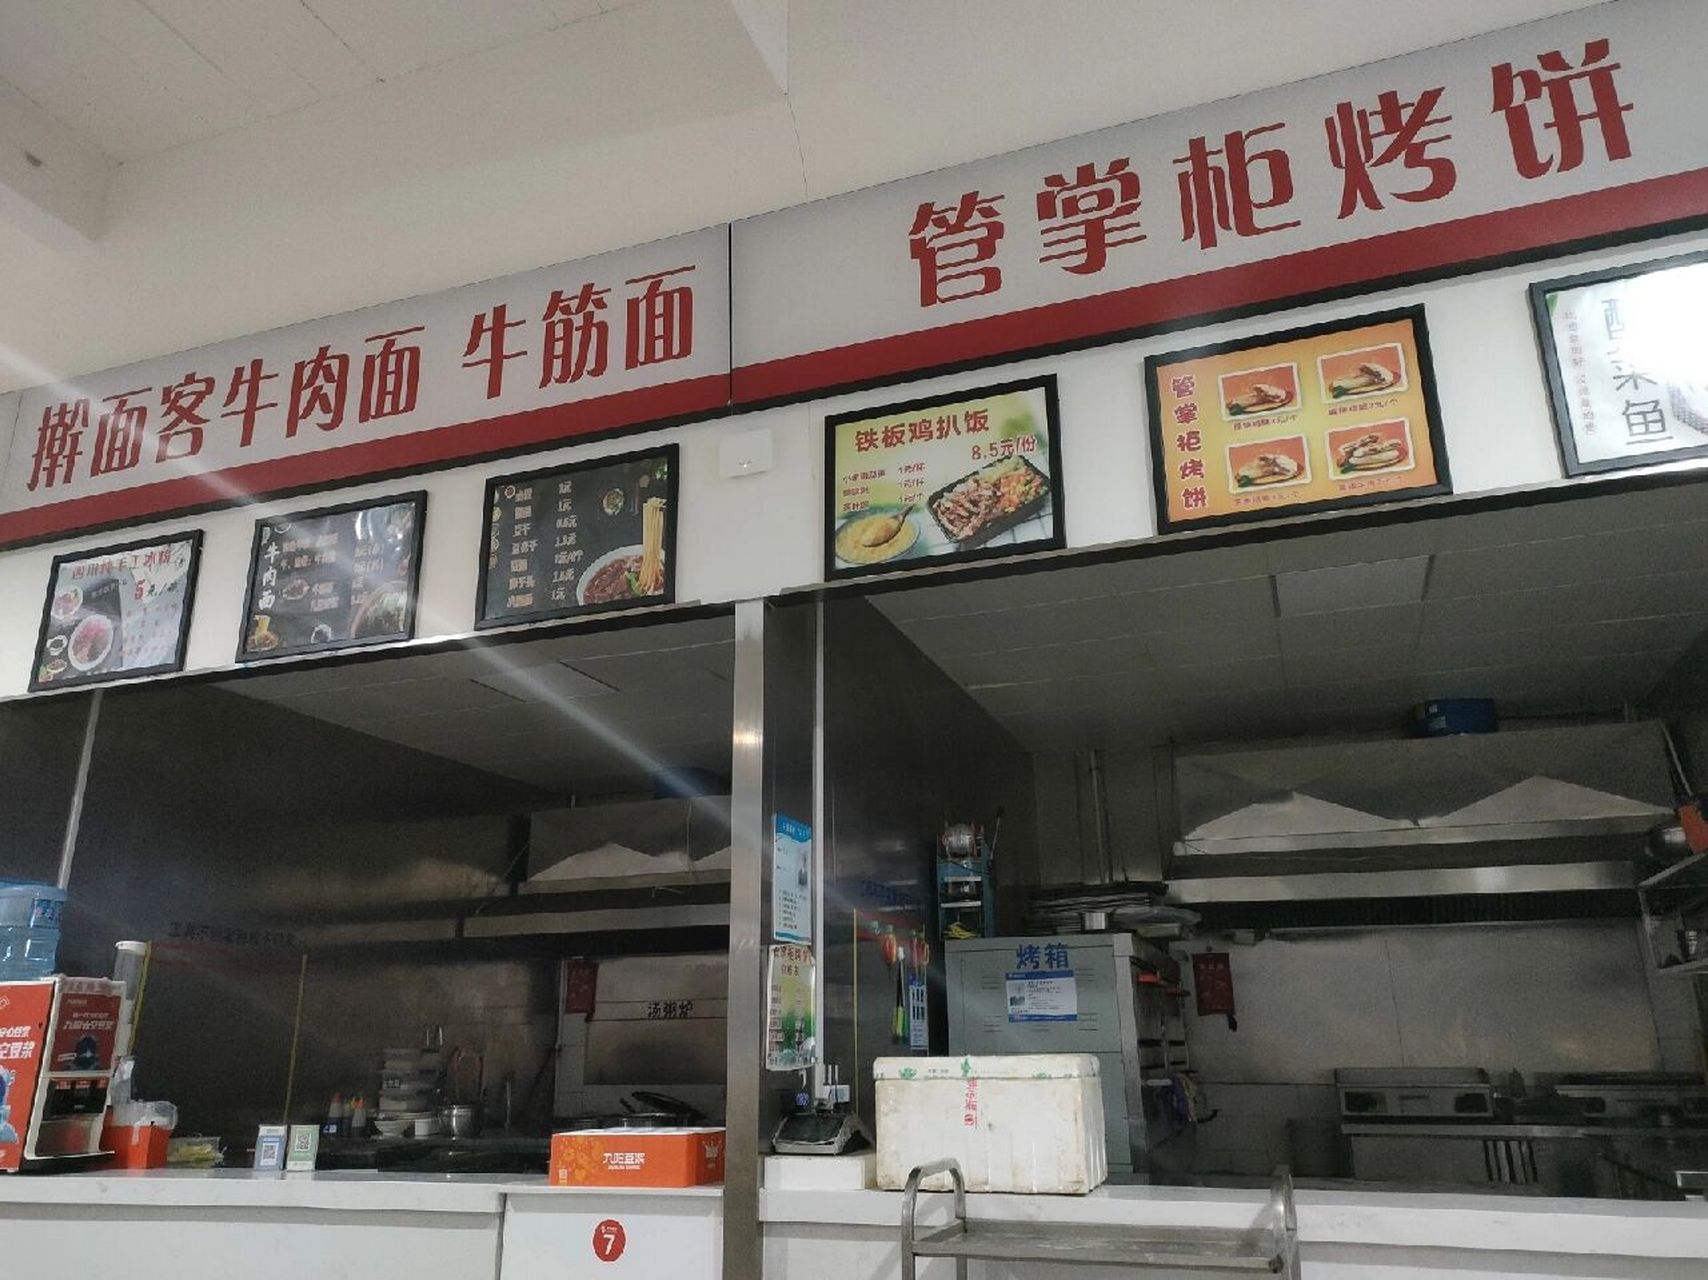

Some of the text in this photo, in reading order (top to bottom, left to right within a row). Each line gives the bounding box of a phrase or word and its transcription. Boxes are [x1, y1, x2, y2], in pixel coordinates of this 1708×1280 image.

[908, 38, 1637, 308] 管掌柜烤饼
[26, 264, 697, 492] 擀面客牛肉面 牛筋面
[855, 408, 990, 452] 铁板鸡扒饭
[971, 434, 1038, 461] 8.5元/份
[1171, 374, 1209, 509] 管掌柜烤饼
[1016, 943, 1069, 969] 烤箱
[602, 1152, 646, 1166] 九阳豆浆
[603, 1234, 616, 1255] 7
